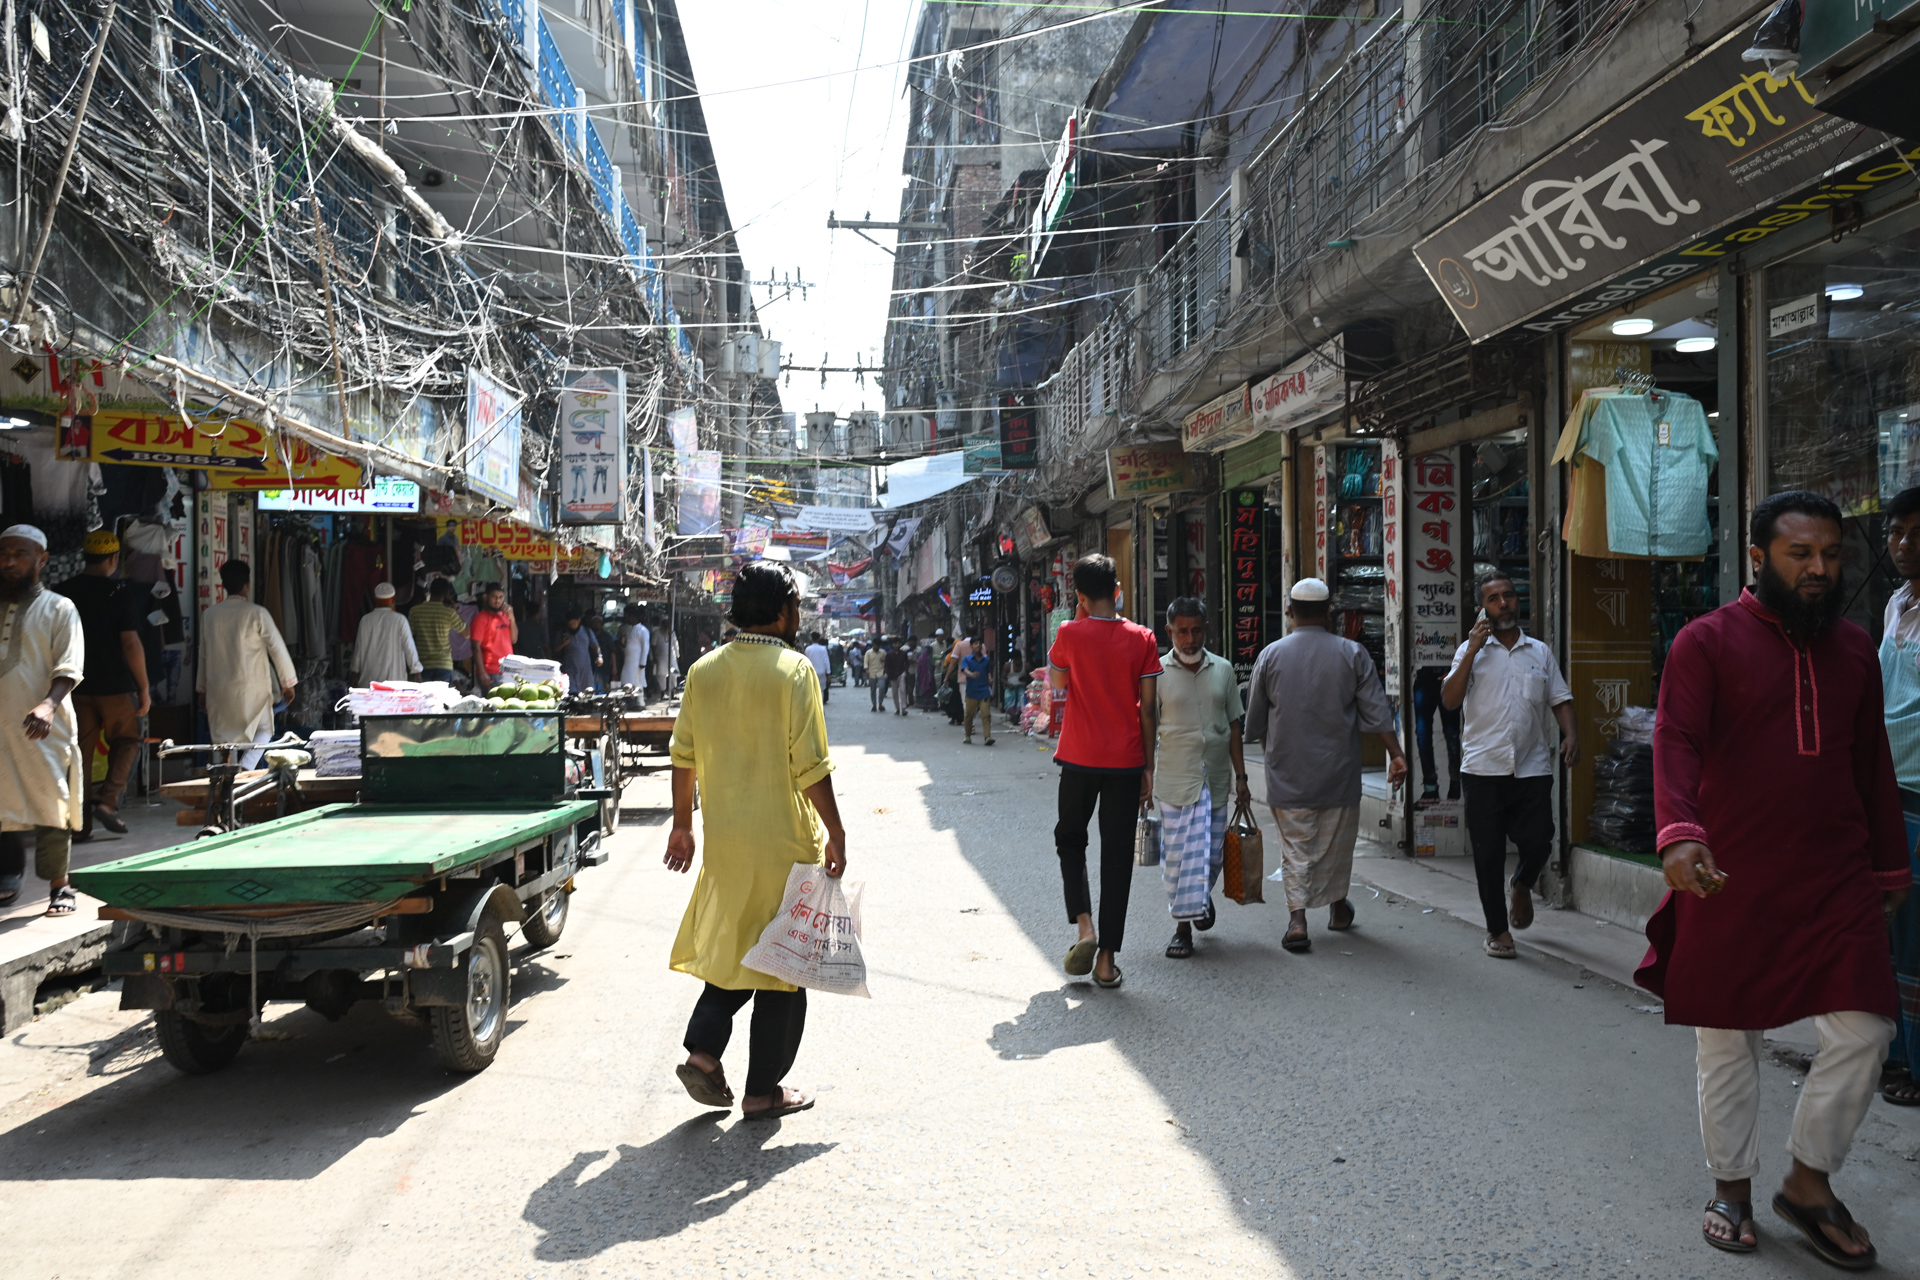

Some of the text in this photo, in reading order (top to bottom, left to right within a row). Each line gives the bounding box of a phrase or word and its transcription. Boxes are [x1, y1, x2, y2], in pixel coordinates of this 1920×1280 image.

[1463, 70, 1818, 287] আরিবা ফ্যাশ
[1523, 263, 1700, 333] Areeba
[131, 452, 236, 466] BOSS-2
[1233, 507, 1260, 601] সহিদুল
[1417, 582, 1456, 601] প্যান্ট
[1416, 603, 1456, 617] হাউস
[1418, 651, 1433, 660] Pant
[788, 930, 810, 943] এন্ড
